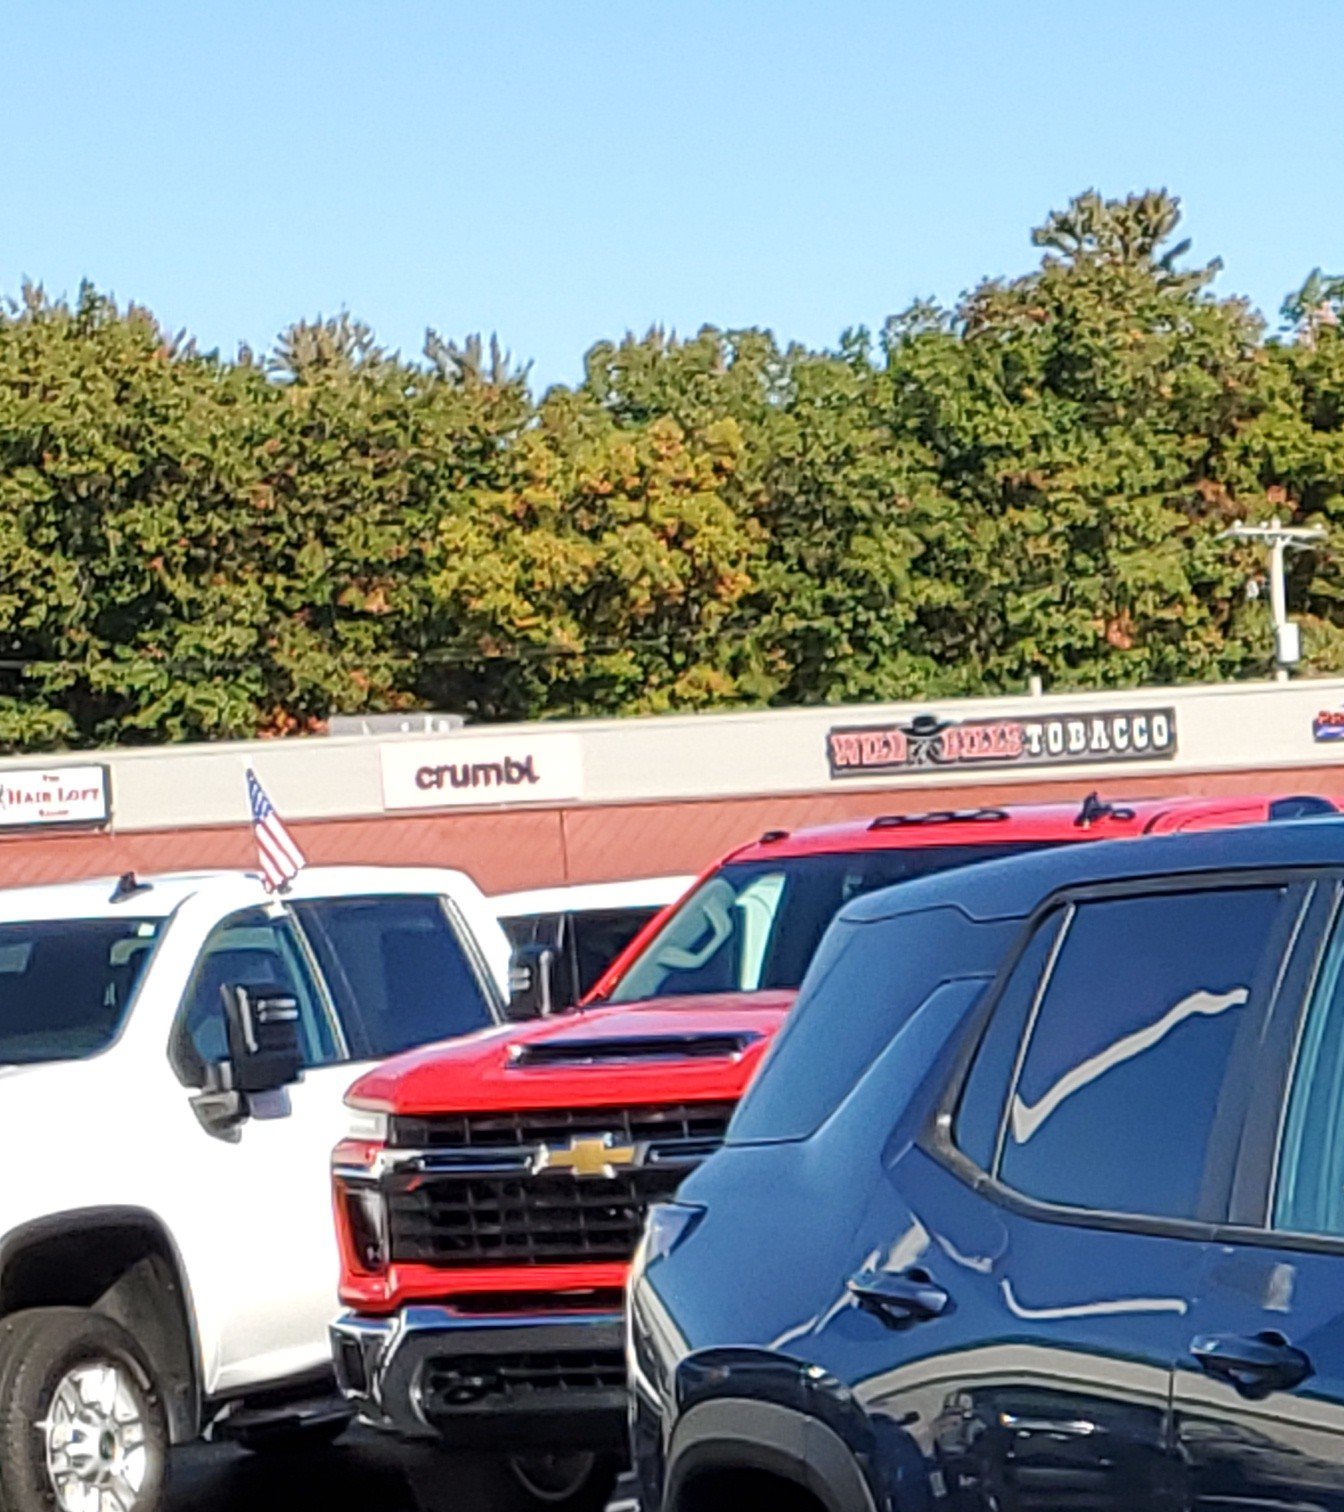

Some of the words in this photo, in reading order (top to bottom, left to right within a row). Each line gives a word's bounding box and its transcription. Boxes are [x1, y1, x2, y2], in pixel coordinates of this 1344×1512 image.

[831, 730, 907, 767] WILD
[1025, 714, 1170, 756] TOBACCO
[415, 755, 541, 790] crumbl
[7, 789, 52, 805] HAIR
[58, 787, 99, 801] LOFT
